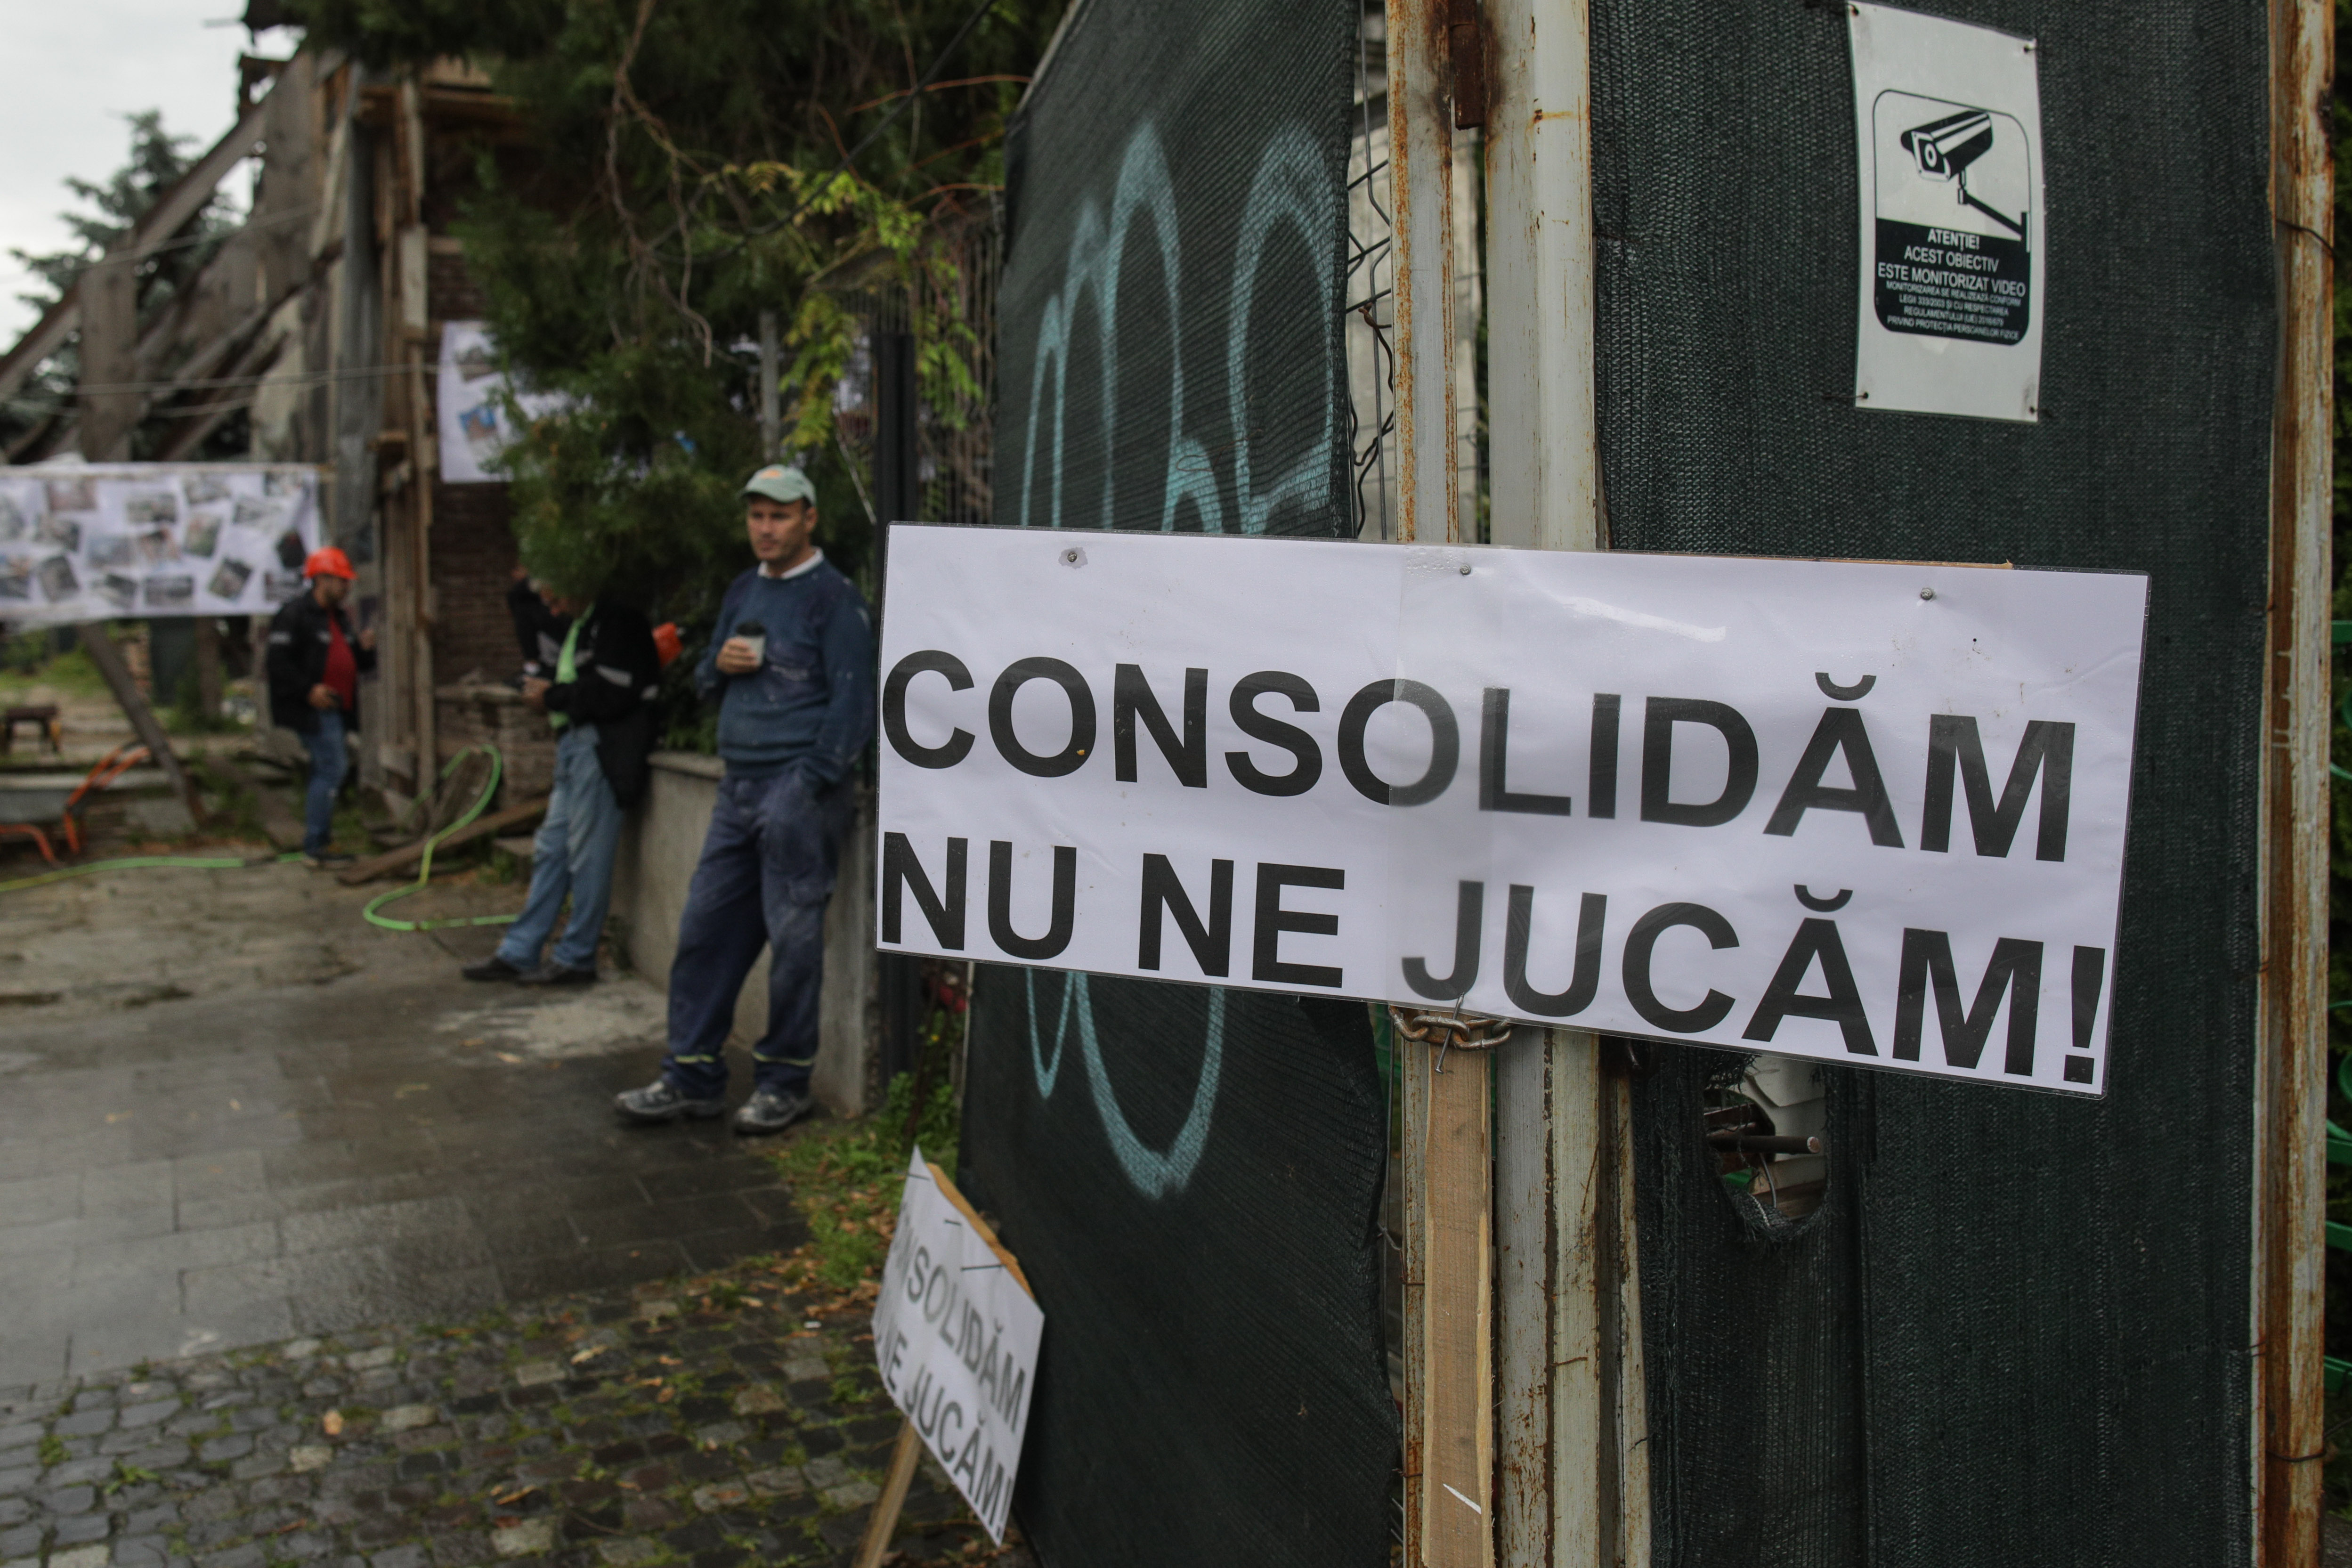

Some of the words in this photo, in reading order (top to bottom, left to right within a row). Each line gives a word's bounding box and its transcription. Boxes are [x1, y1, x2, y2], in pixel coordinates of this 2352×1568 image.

[1878, 262, 1909, 281] ESTE
[1912, 267, 1989, 291] MONITORIZAT
[1991, 278, 2025, 297] VIDEO
[1904, 245, 1944, 265] ACEST
[1946, 251, 1999, 273] OBIECTIV
[1940, 287, 1950, 298] SE
[882, 649, 2076, 862] CONSOLIDĂM
[882, 831, 1077, 960] NU
[1138, 853, 1345, 988] NE
[1401, 879, 2106, 1085] JUCĂM!
[904, 1363, 1014, 1541] JUCĂM!
